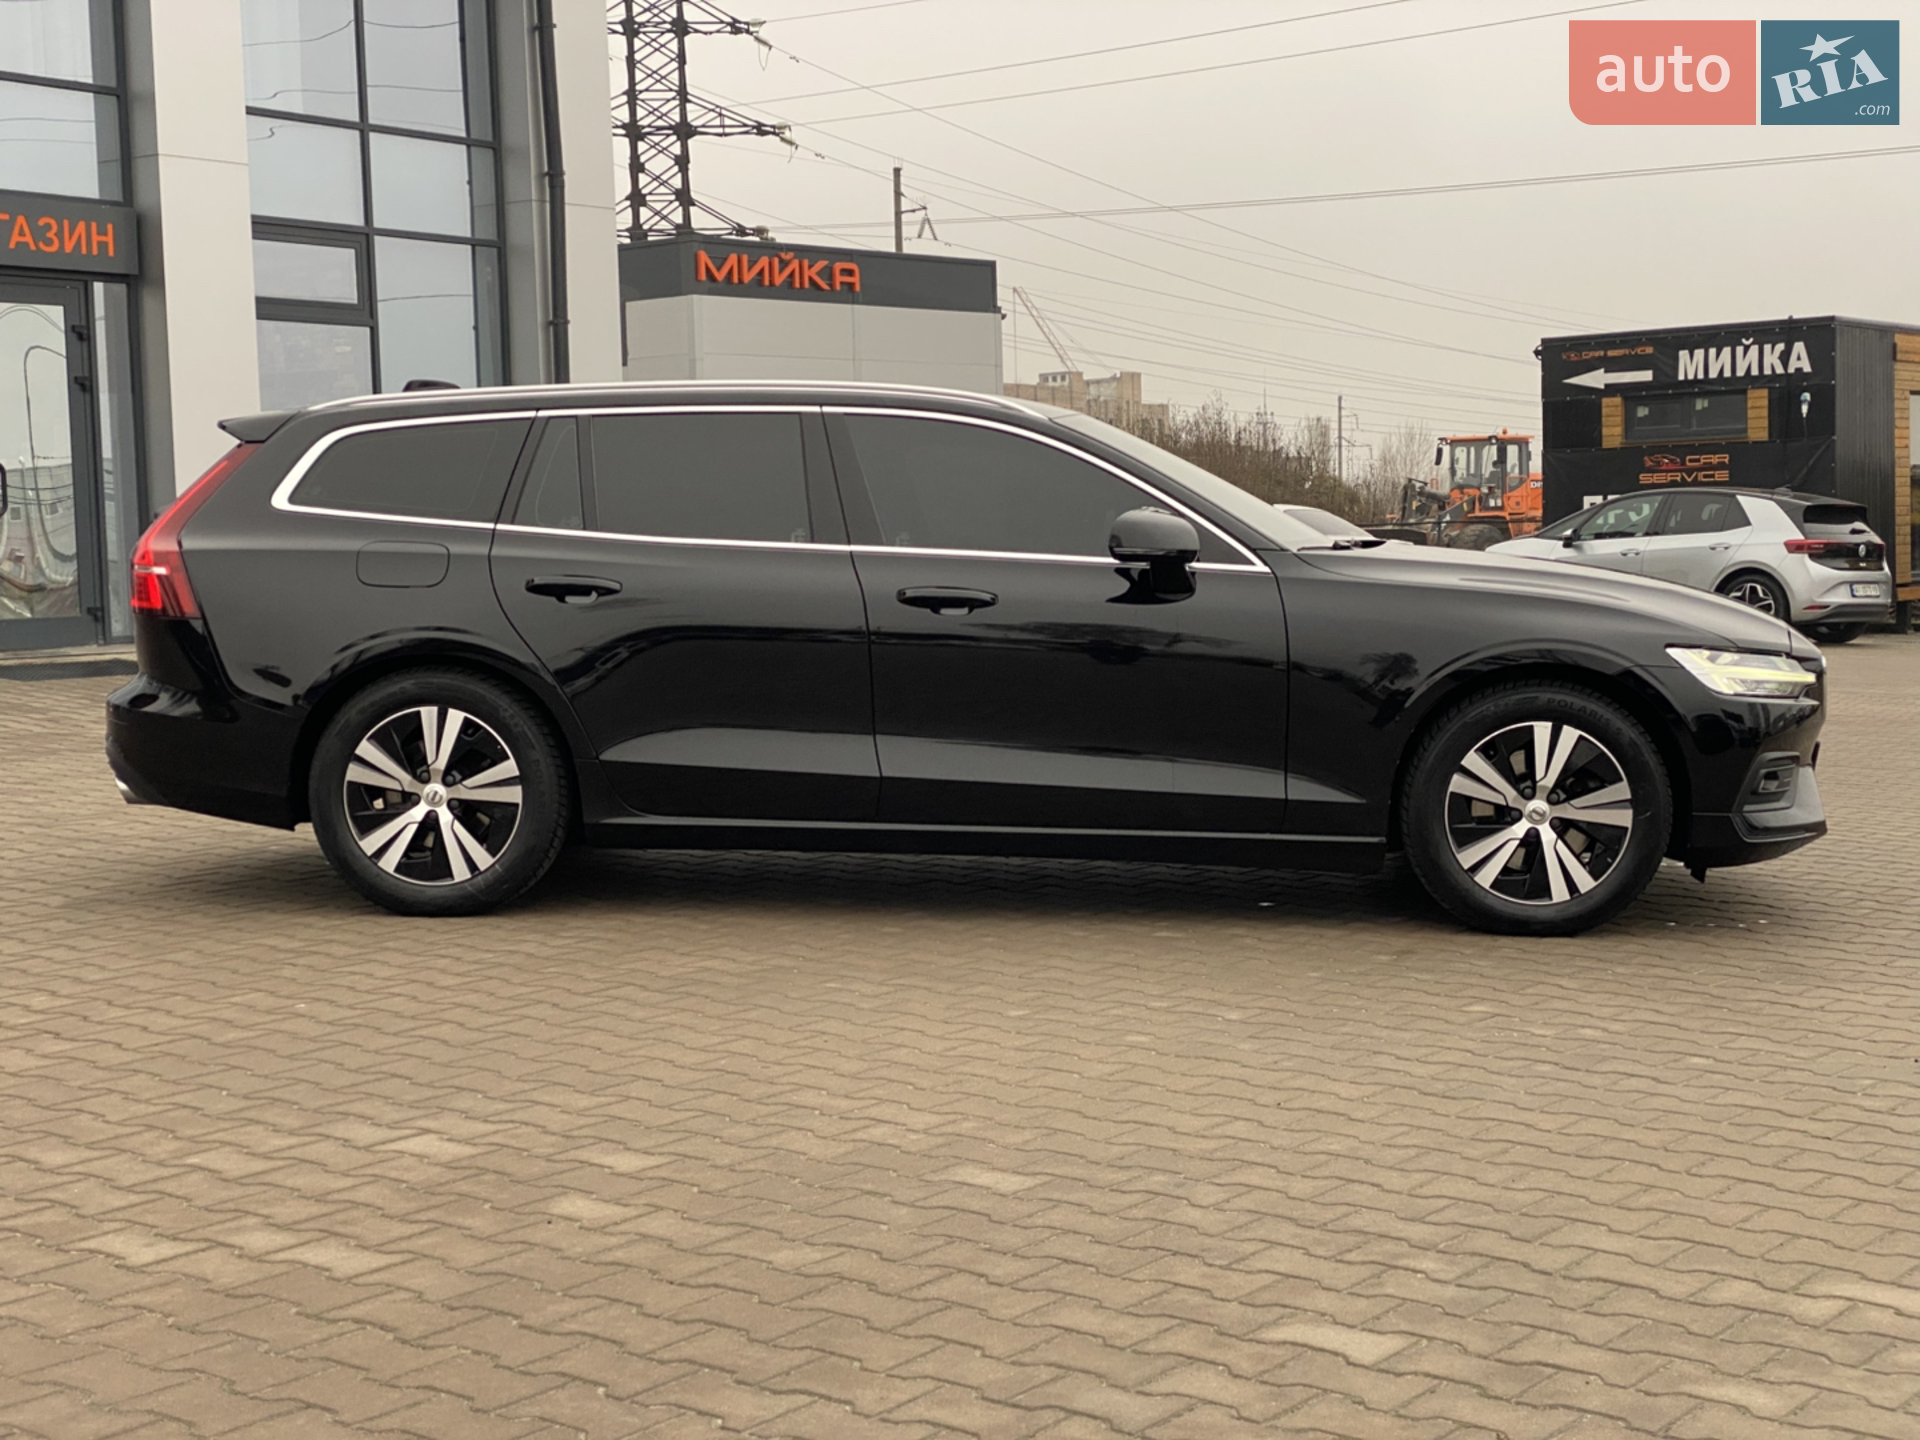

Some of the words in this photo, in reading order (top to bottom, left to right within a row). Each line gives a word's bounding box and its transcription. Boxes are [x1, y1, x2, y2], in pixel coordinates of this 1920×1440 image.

[696, 250, 861, 291] МИЙКА
[1678, 337, 1812, 380] МИЙКА
[1686, 454, 1729, 466] CAR
[1639, 470, 1729, 484] SERVICE
